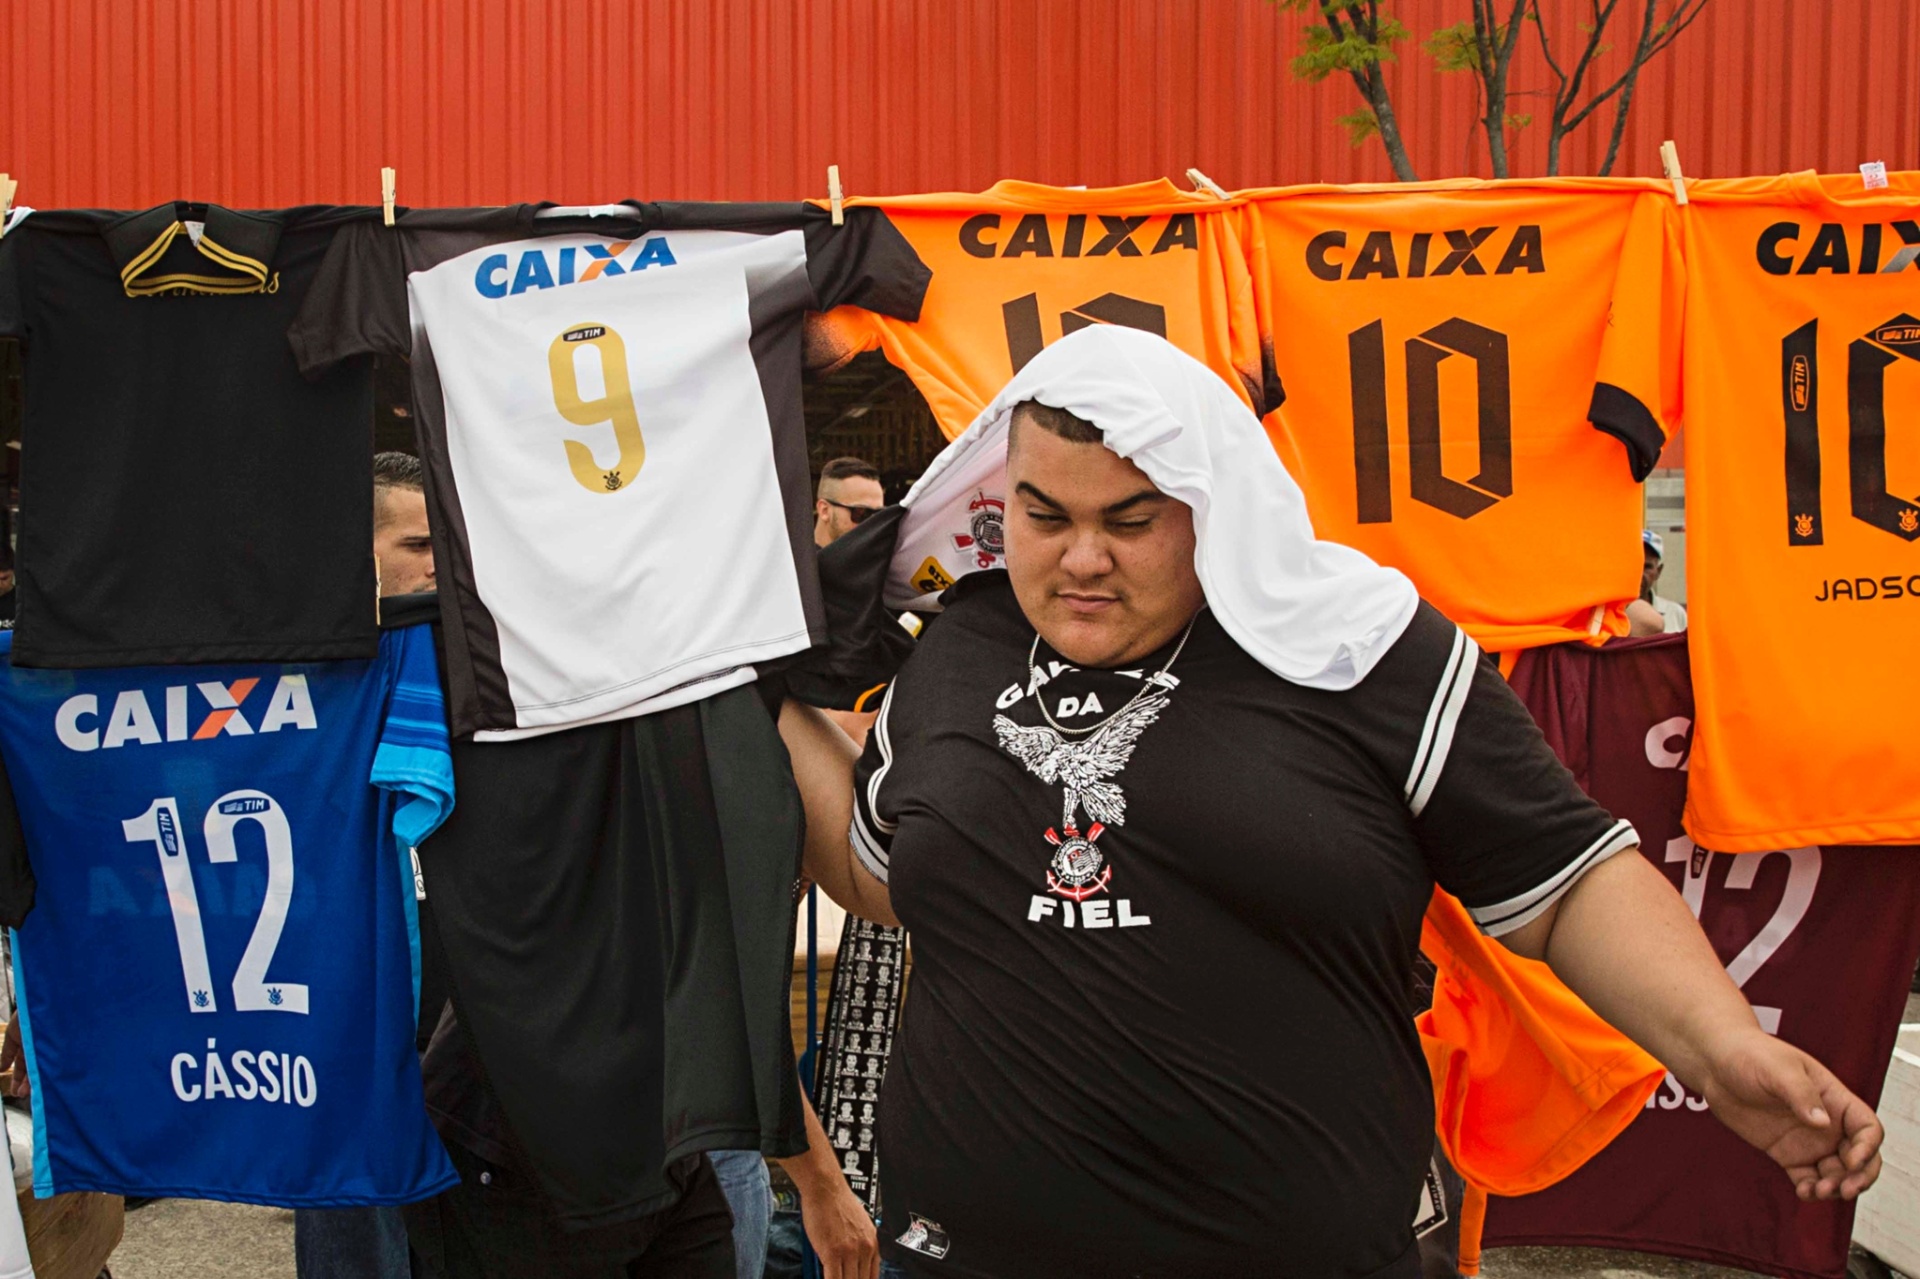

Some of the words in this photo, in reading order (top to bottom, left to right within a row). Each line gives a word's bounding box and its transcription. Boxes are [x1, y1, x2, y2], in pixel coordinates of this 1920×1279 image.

[958, 213, 1199, 259] CAIXA
[1305, 225, 1546, 281] CAIXA
[1756, 220, 1920, 275] CAIX
[475, 237, 677, 299] CAIXA
[584, 328, 601, 338] TIM
[1795, 362, 1805, 383] TIM
[548, 322, 645, 494] 9
[1348, 316, 1513, 524] 10
[1782, 313, 1920, 546] 10
[55, 674, 317, 752] CAIXA
[1056, 691, 1104, 718] DA
[159, 812, 172, 832] TIM
[244, 799, 265, 810] TIM
[122, 789, 309, 1015] 12
[1028, 895, 1151, 929] FIEL
[170, 1037, 317, 1108] CÁSSIO
